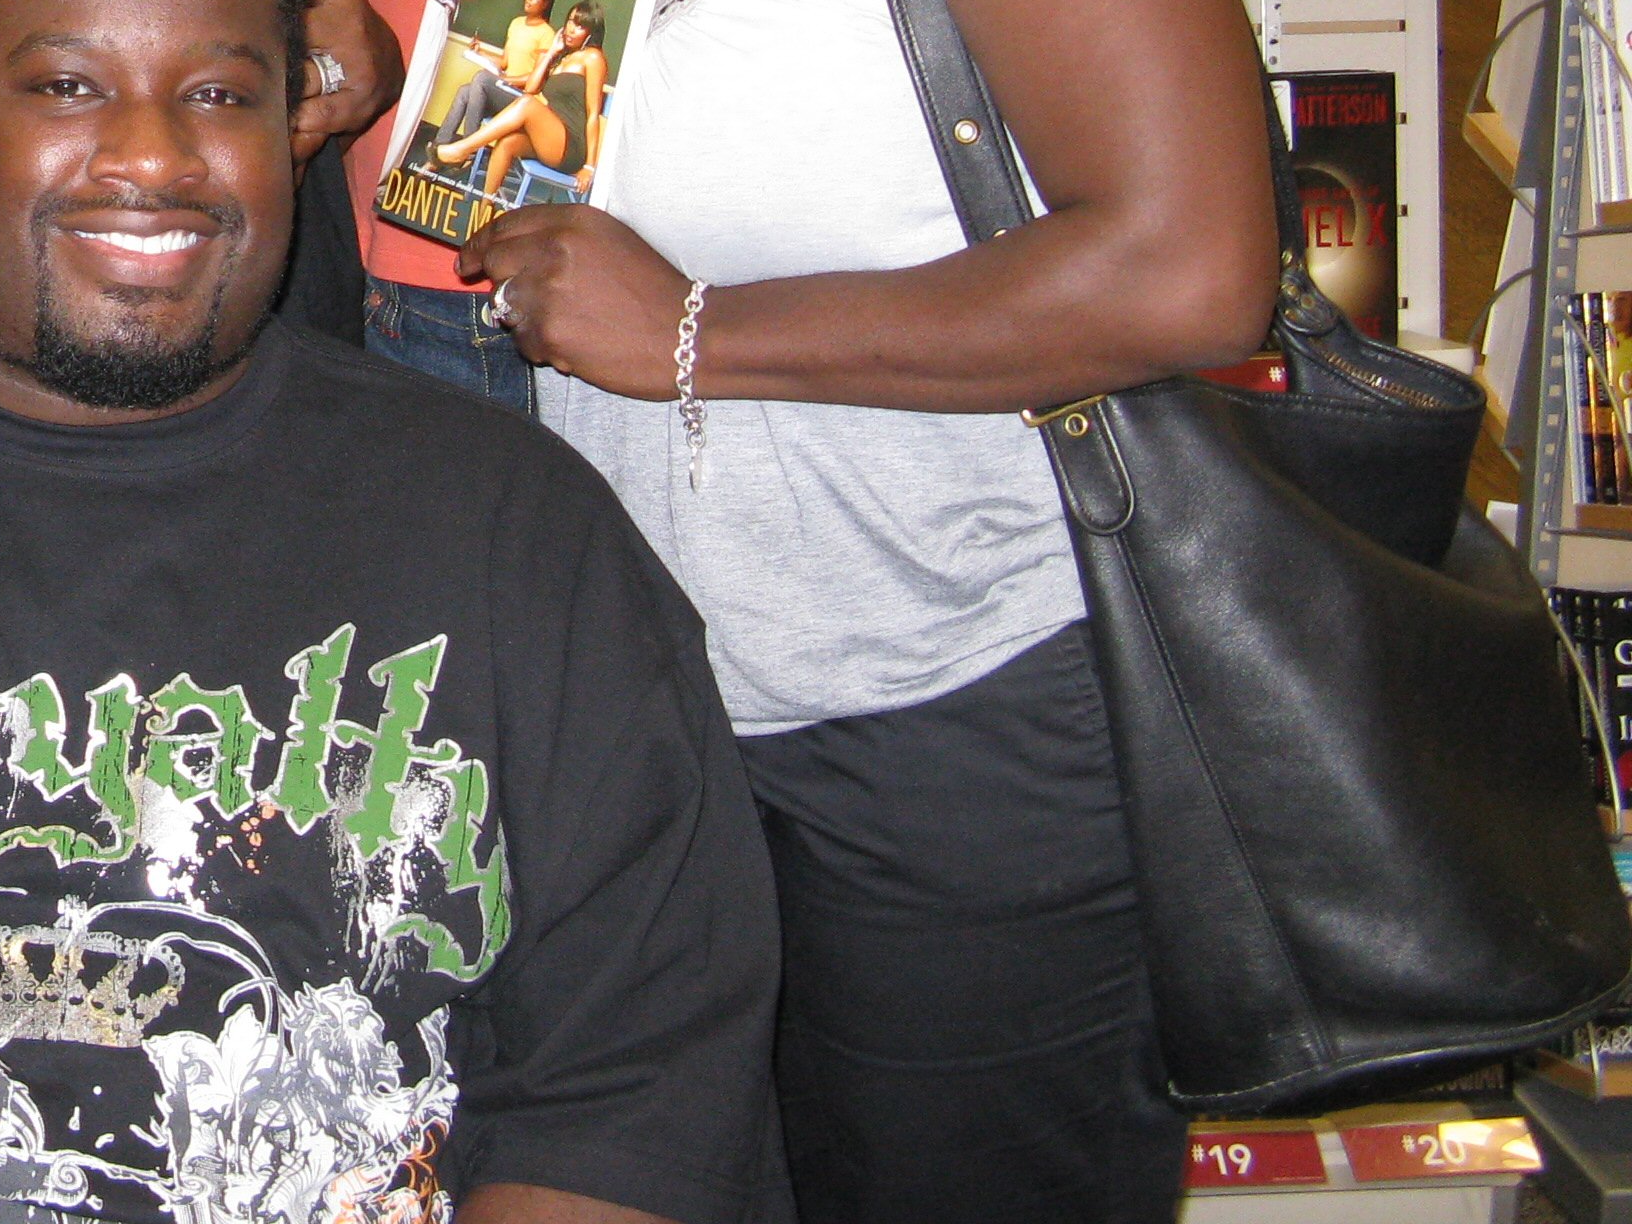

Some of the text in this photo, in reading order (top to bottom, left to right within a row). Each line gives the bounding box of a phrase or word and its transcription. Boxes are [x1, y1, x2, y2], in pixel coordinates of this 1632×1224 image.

[382, 167, 464, 237] DANTE
[1367, 202, 1388, 248] X
[1191, 1133, 1468, 1176] #19 #20
